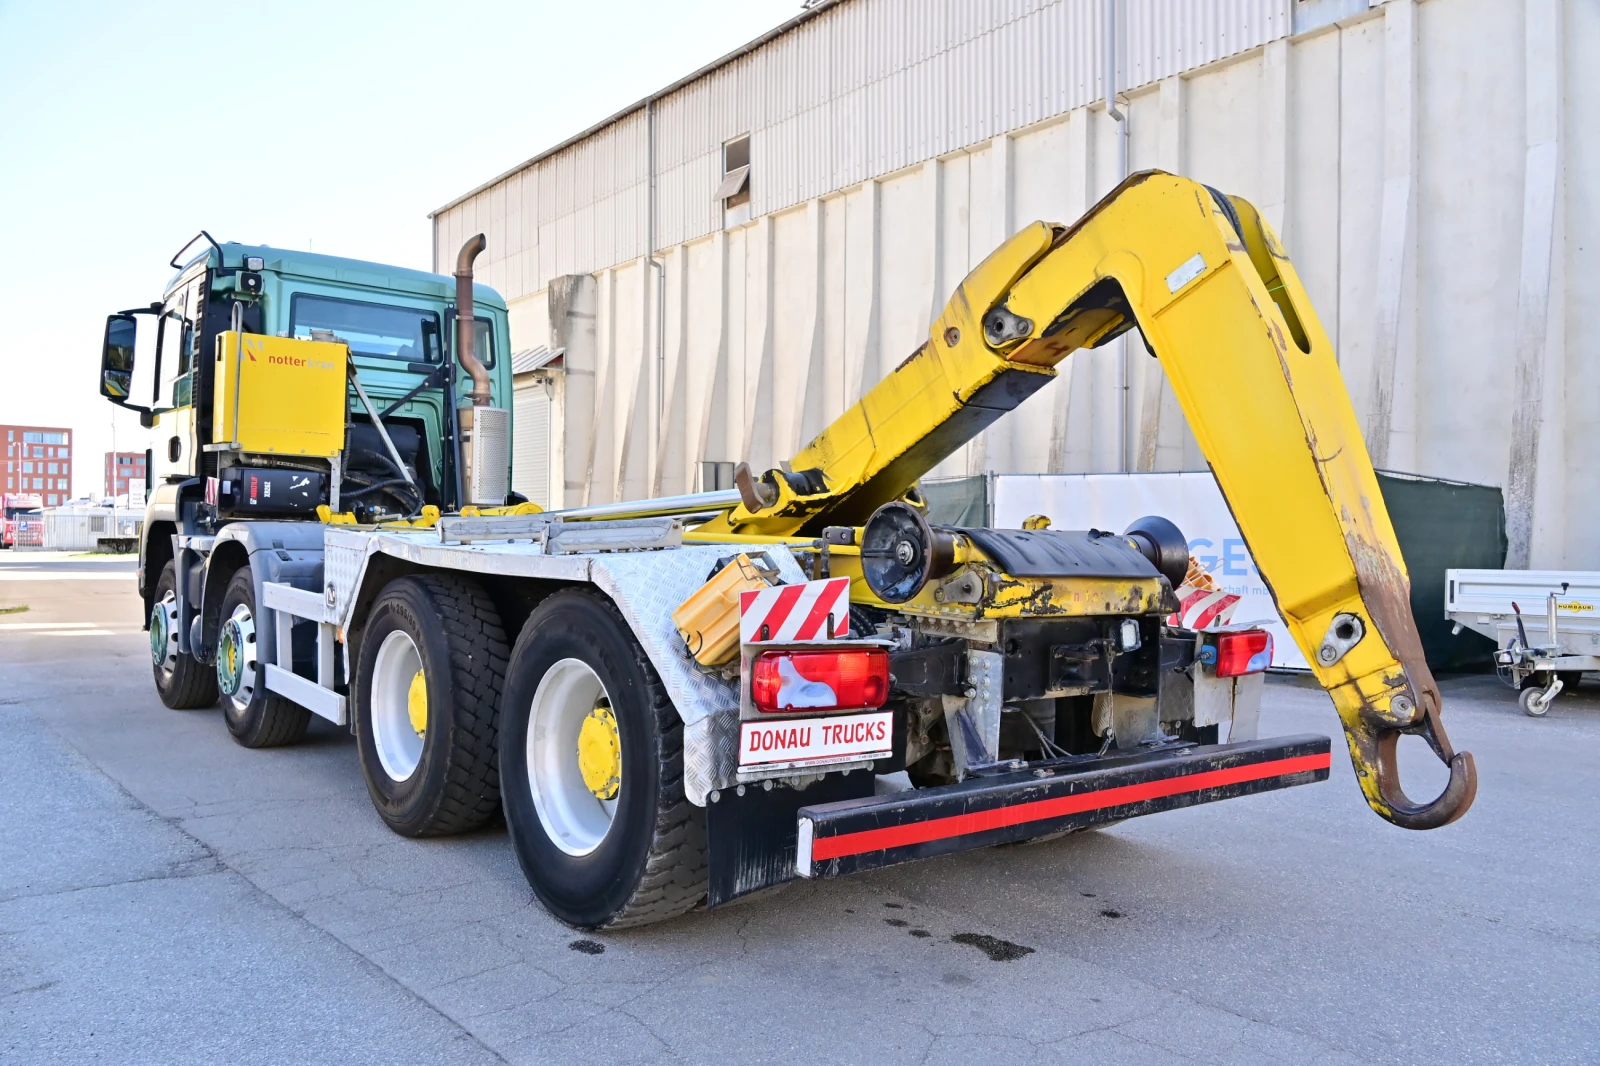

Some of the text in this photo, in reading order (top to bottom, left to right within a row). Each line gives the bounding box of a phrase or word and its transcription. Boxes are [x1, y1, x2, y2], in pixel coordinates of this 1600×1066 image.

[1188, 538, 1259, 576] GE
[1222, 584, 1270, 596] chaft mb
[749, 720, 886, 752] DONAU TRUCKS
